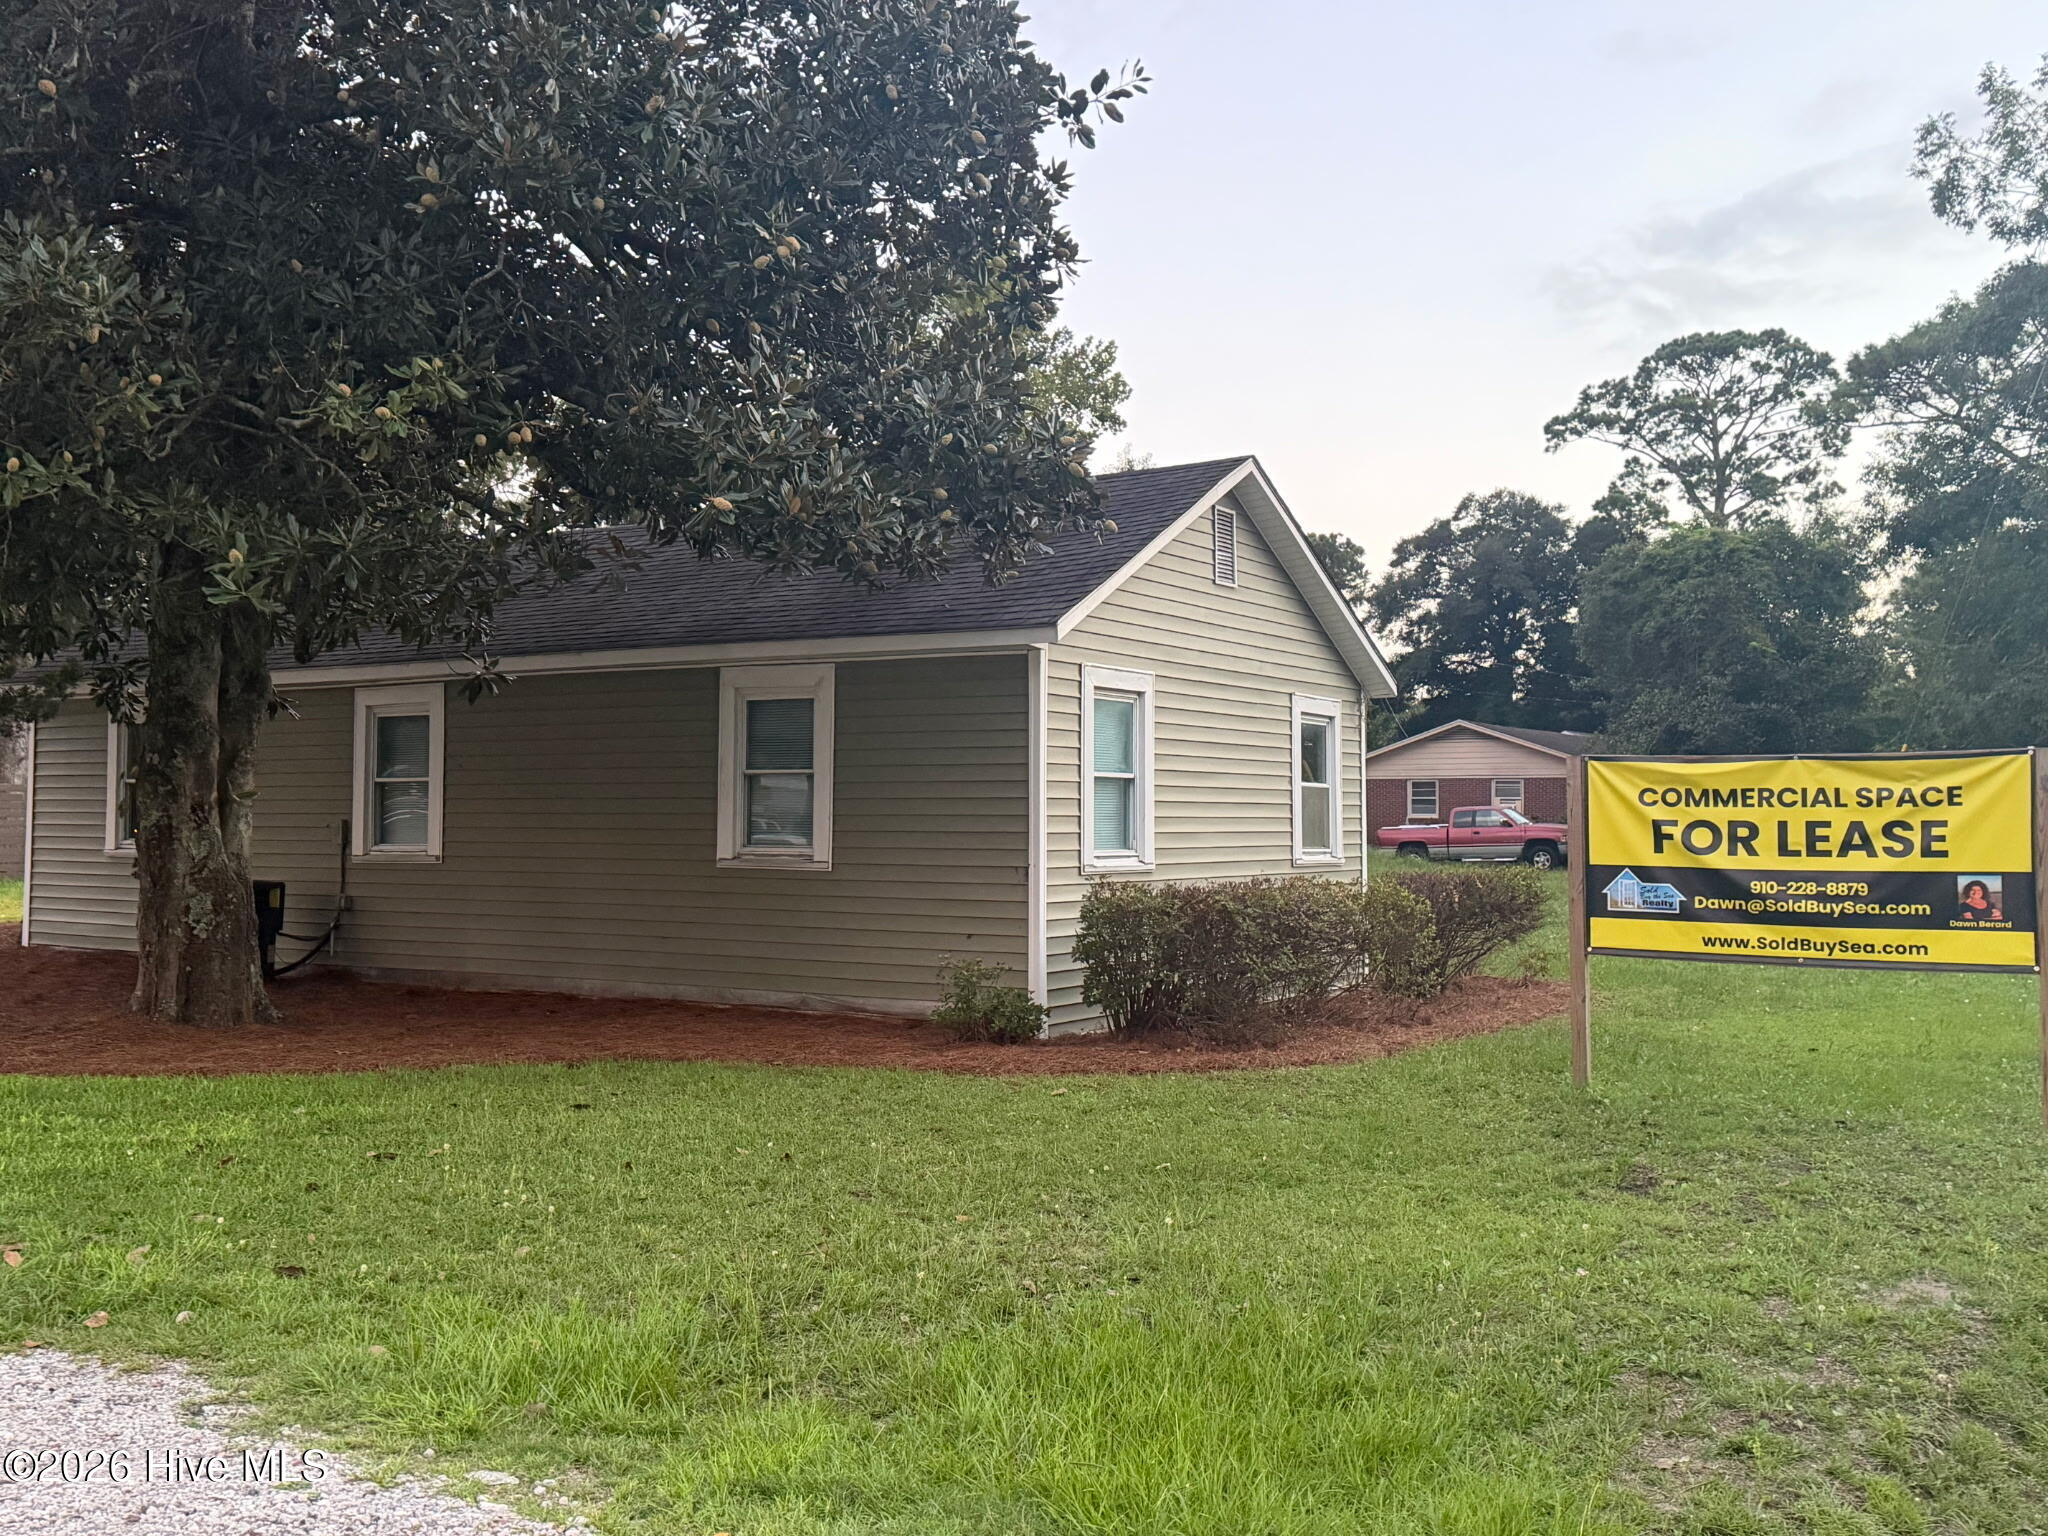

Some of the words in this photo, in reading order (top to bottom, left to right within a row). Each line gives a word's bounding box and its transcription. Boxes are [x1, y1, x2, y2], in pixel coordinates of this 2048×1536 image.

[1638, 787, 1848, 809] COMMERCIAL
[1856, 785, 1964, 808] SPACE
[1652, 819, 1760, 857] FOR
[1777, 819, 1950, 859] LEASE
[1750, 880, 1869, 897] 910-228-8879
[1642, 899, 1674, 907] Realty
[1694, 896, 1931, 917] Dawn@SoldBuySea.com
[1949, 920, 1977, 928] Dawn
[1979, 920, 2012, 929] Berard
[1702, 936, 1928, 957] www.SoldBuySea.com
